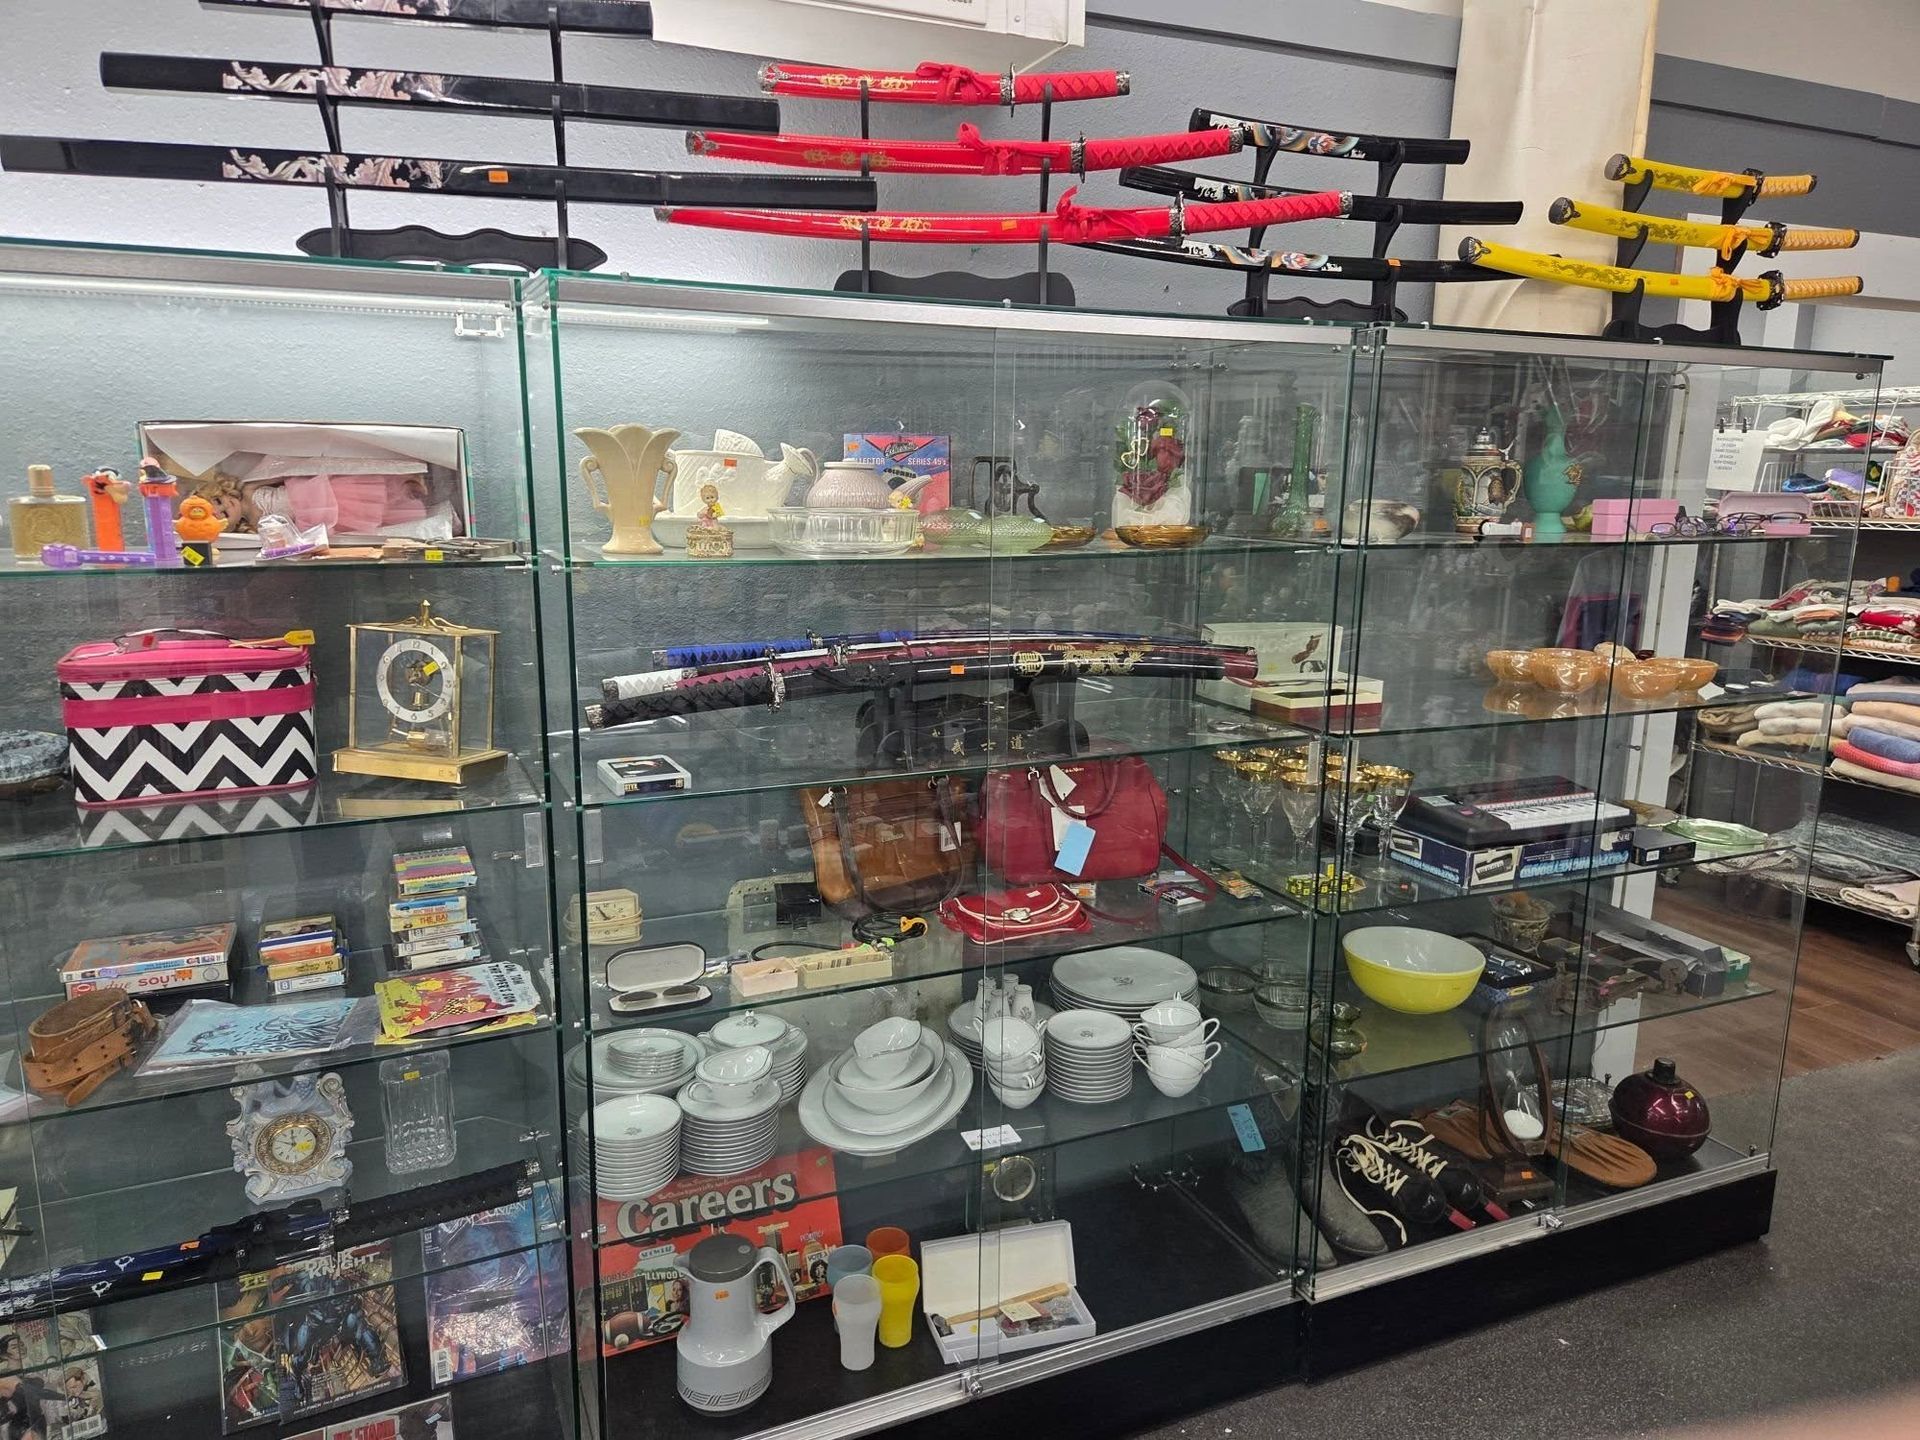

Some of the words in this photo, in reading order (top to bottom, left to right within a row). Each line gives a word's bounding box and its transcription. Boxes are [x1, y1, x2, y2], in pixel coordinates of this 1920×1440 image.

[907, 457, 931, 465] SERIES
[138, 974, 192, 987] SOUT
[617, 1173, 797, 1239] Careers
